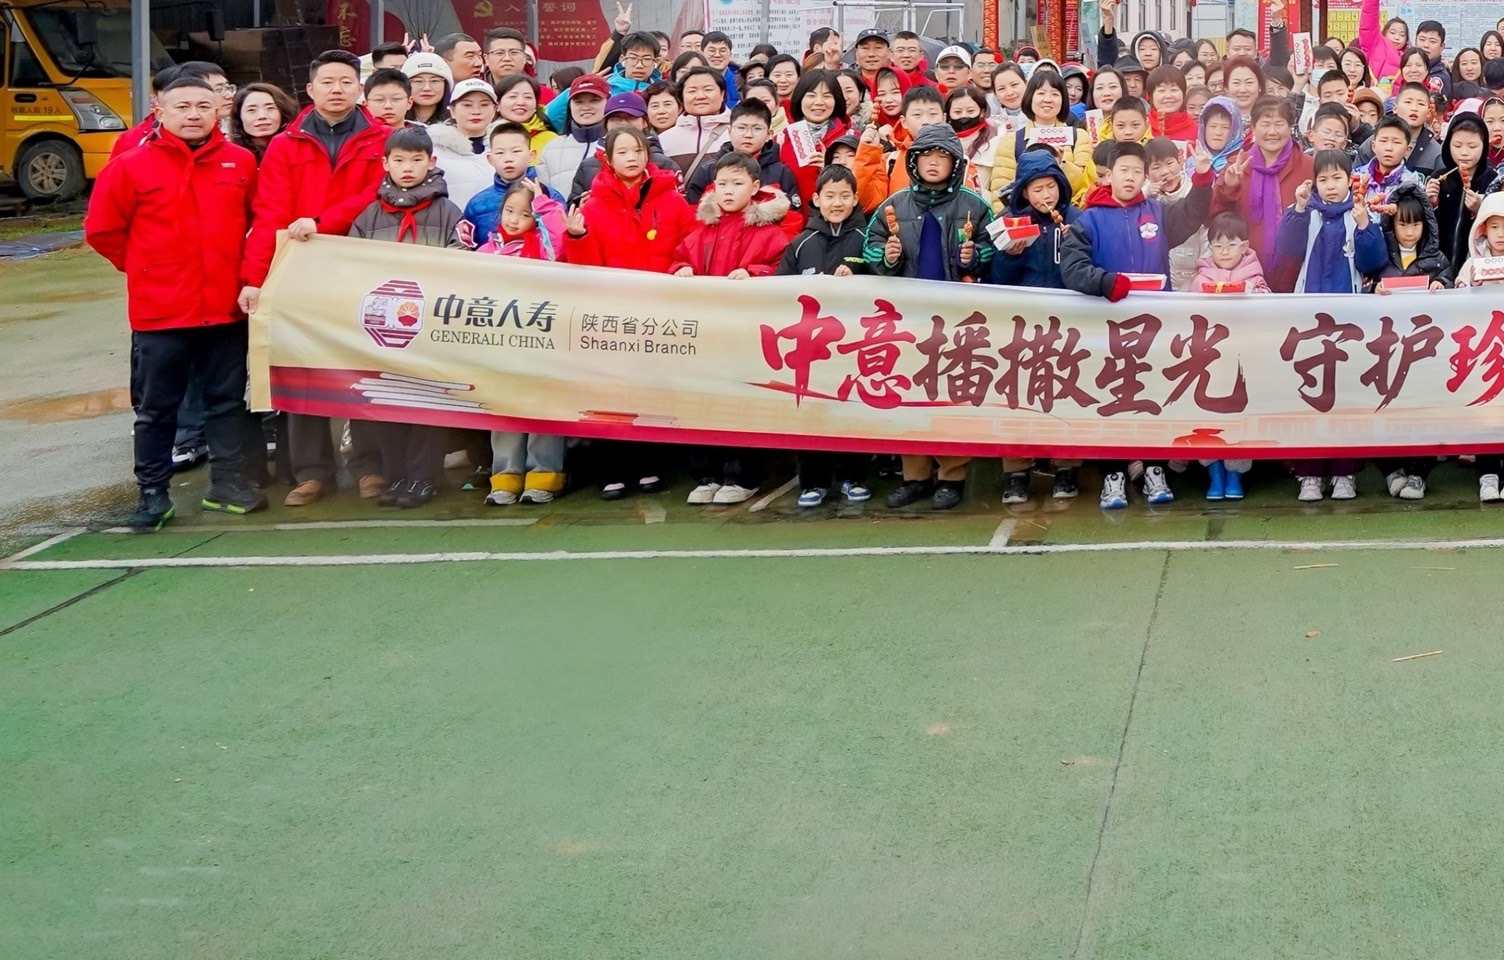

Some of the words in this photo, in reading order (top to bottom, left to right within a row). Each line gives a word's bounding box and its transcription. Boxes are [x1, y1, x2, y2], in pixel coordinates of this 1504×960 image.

[432, 293, 560, 333] 中意人寿
[581, 313, 699, 339] 陕西省分公司
[430, 328, 505, 348] GENERALI
[508, 334, 556, 350] CHINA
[580, 336, 641, 354] Shaanxi
[644, 339, 697, 356] Branch
[759, 294, 1250, 416] 中意播撒星光
